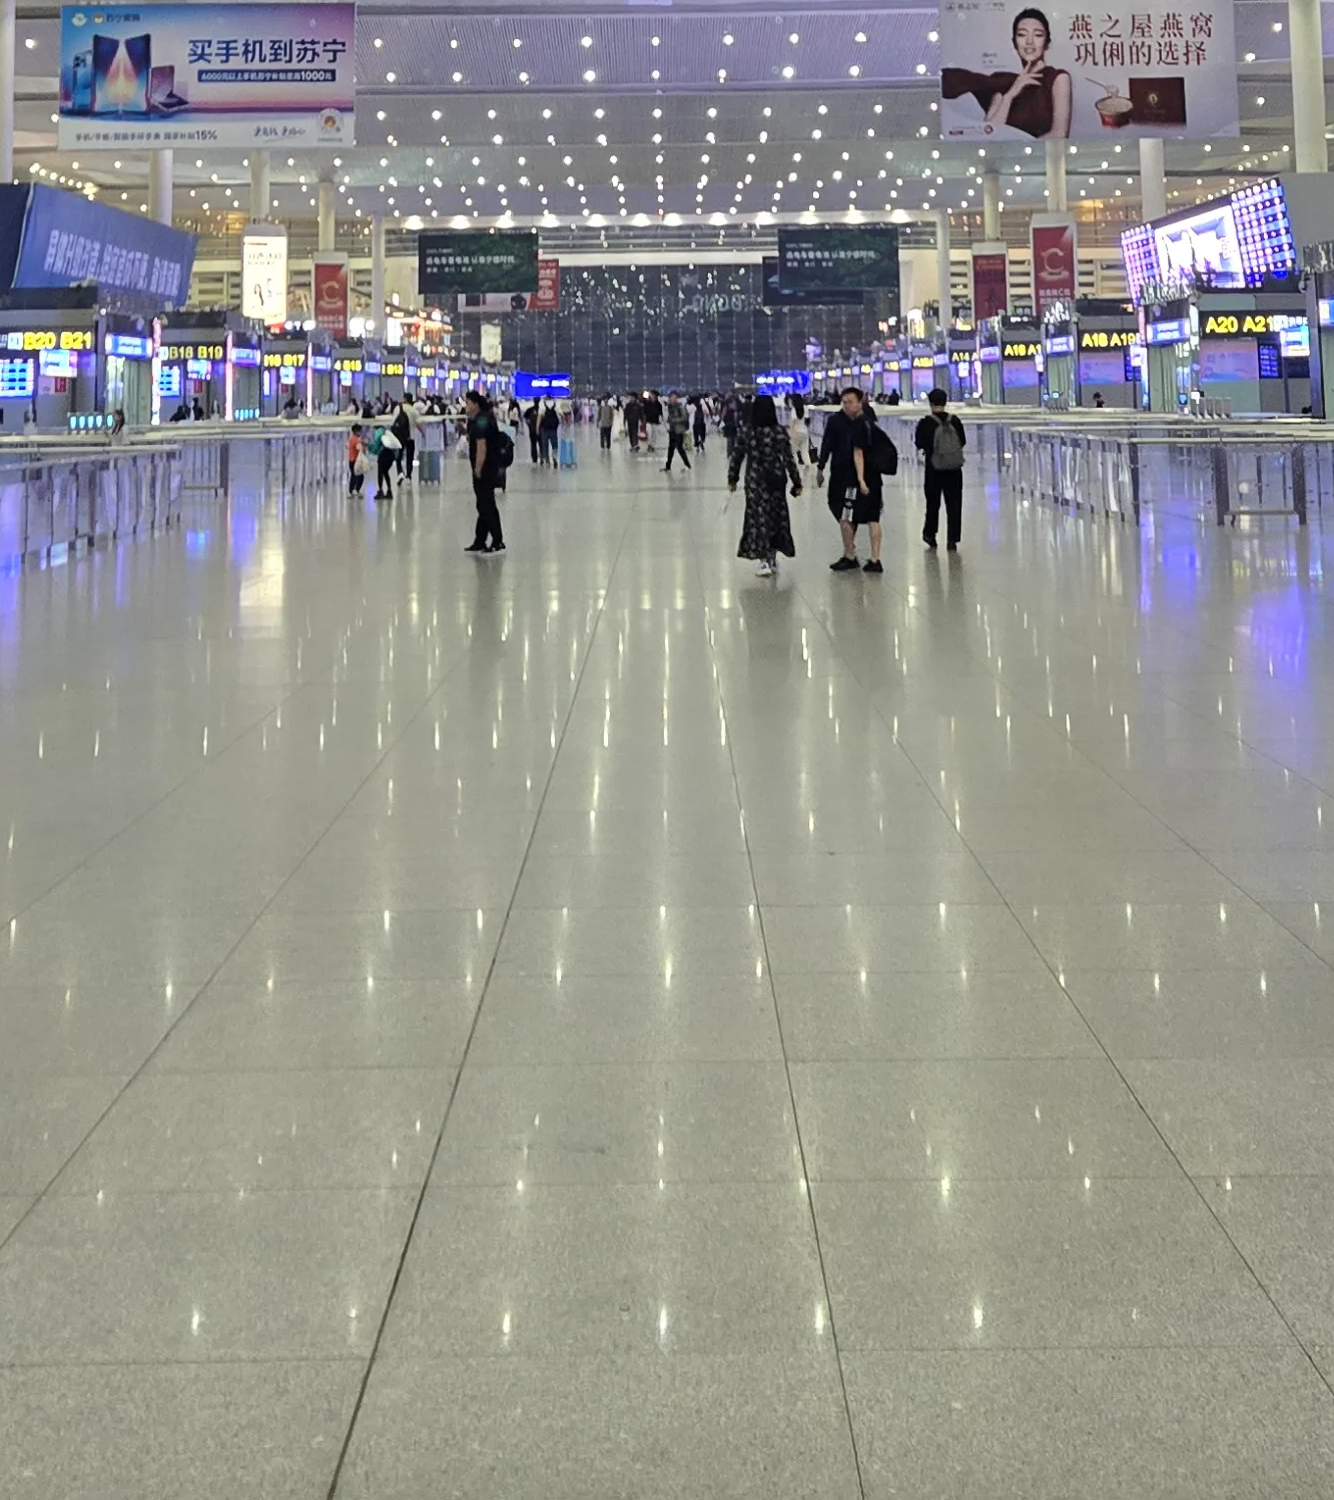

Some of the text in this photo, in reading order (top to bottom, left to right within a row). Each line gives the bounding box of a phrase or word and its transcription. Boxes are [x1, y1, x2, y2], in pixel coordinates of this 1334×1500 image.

[1069, 12, 1213, 40] 燕之屋燕窝
[188, 39, 347, 64] 买手机到苏宁
[1074, 40, 1207, 67] 巩俐的选择
[1206, 316, 1274, 333] A20 A21
[23, 331, 56, 350] B20
[60, 331, 92, 350] B21
[1082, 333, 1108, 347] A18
